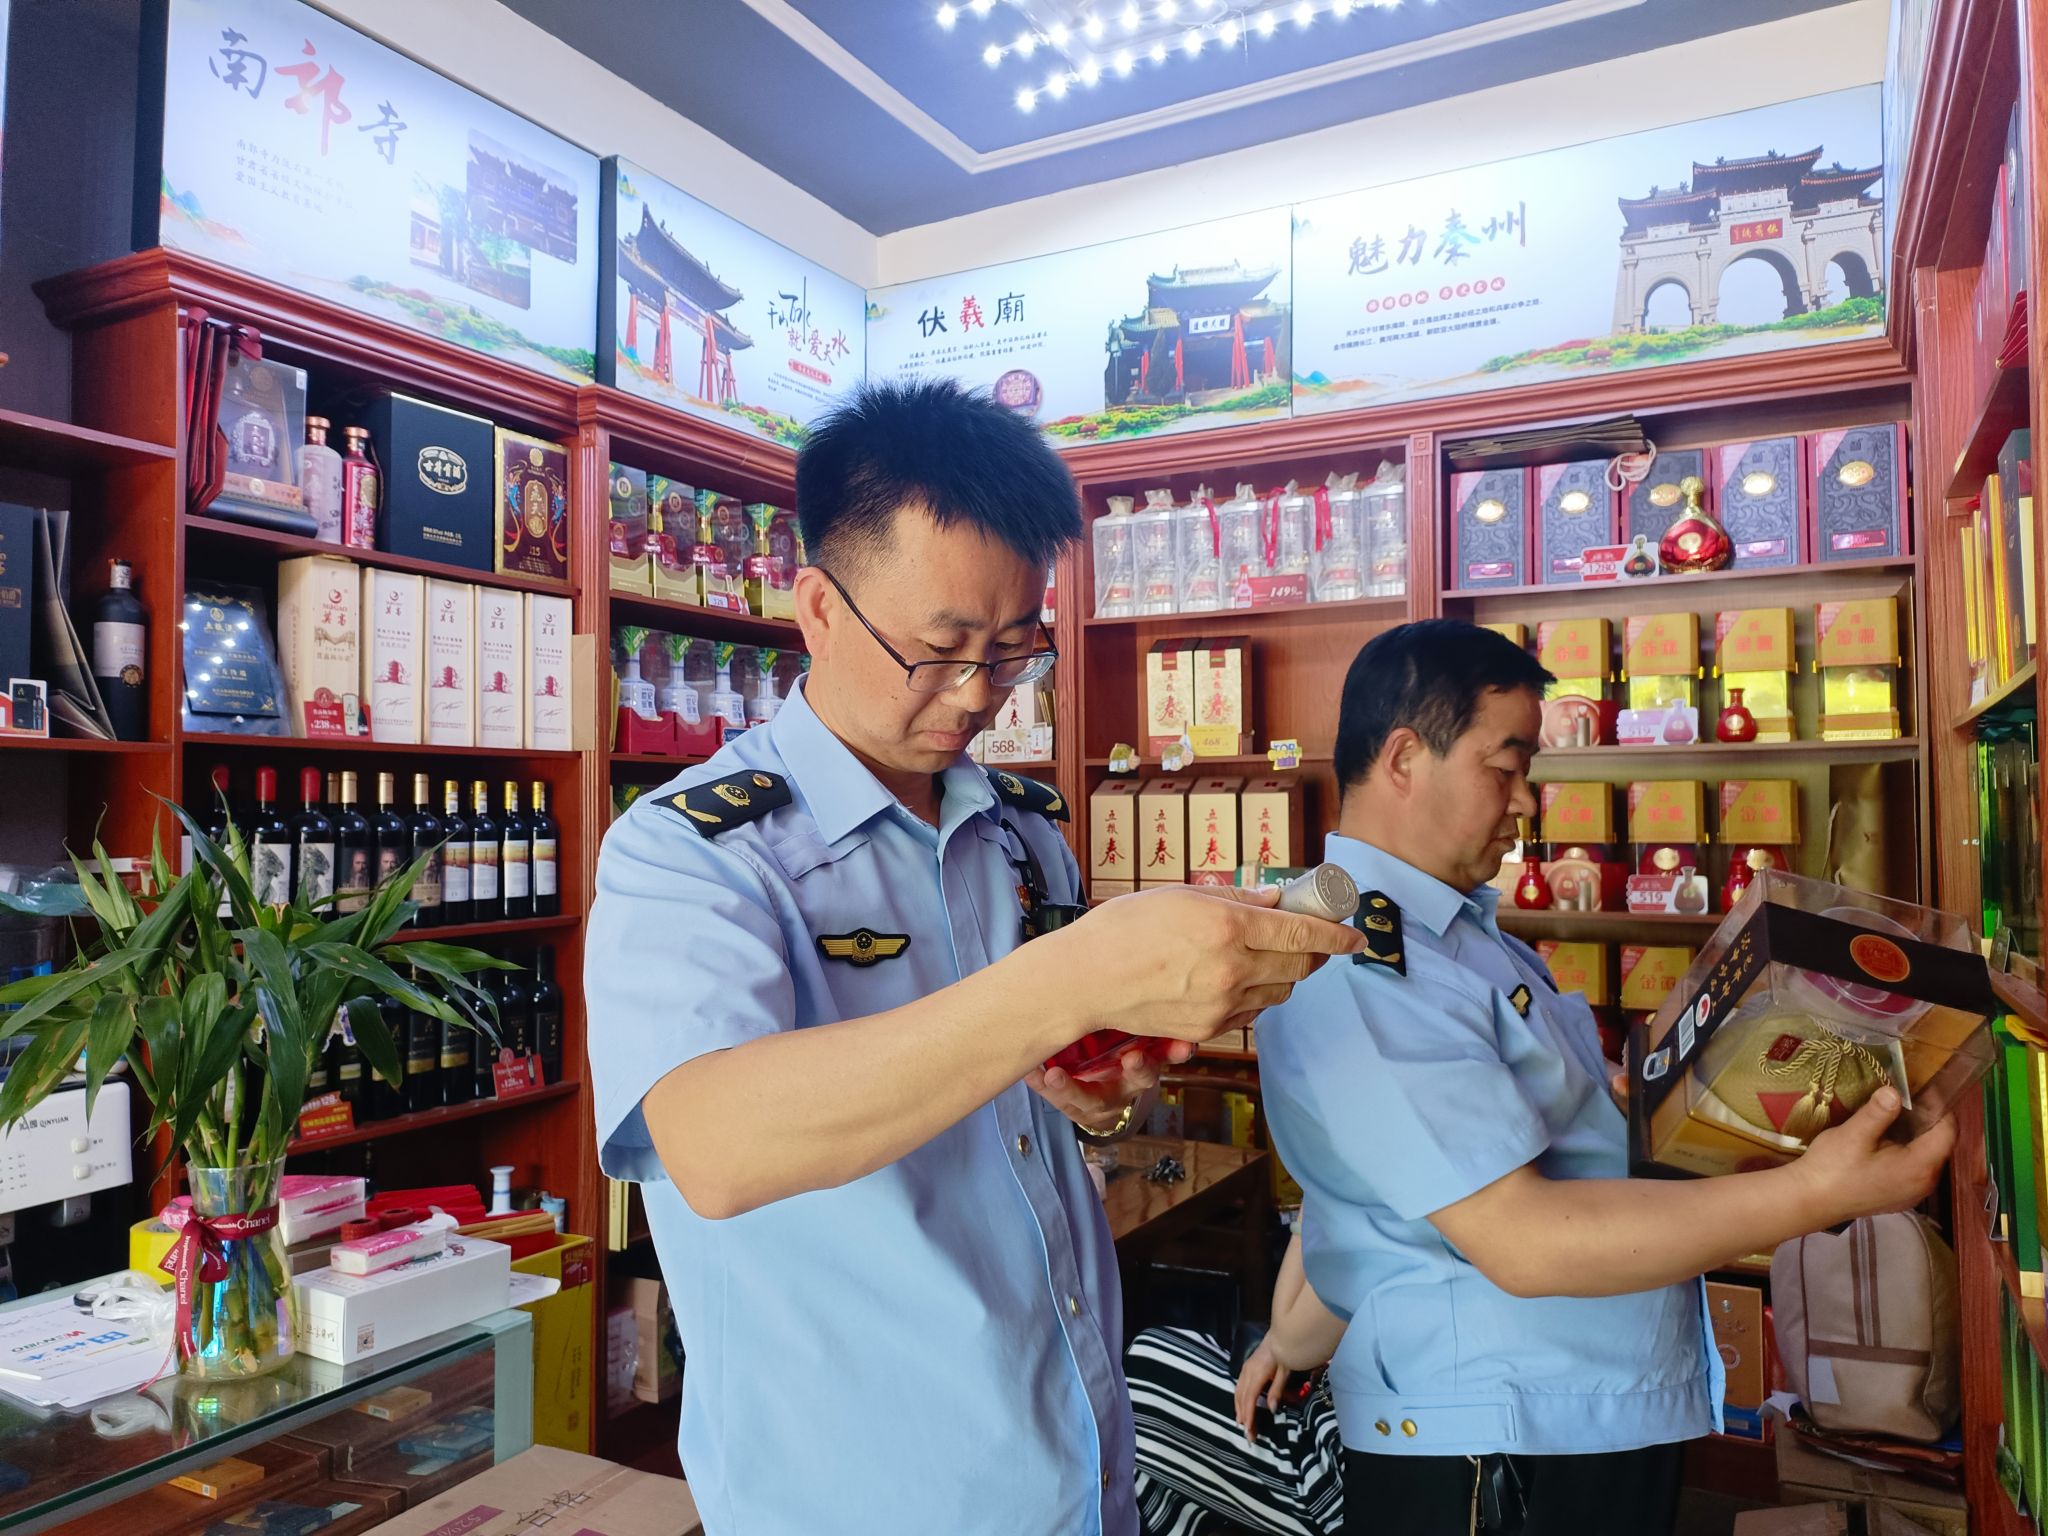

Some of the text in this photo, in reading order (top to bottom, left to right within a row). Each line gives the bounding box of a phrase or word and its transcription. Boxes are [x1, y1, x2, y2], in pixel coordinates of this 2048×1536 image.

[1347, 200, 1526, 276] 魅力秦州
[992, 739, 1015, 754] 568
[1098, 810, 1126, 866] 五粮春
[1147, 809, 1175, 866] 五粮春
[1197, 808, 1226, 867] 五粮春
[1256, 808, 1281, 867] 五粮春
[1638, 891, 1665, 905] 519
[39, 1116, 69, 1128] QINYUAN
[178, 1269, 189, 1305] Chanel
